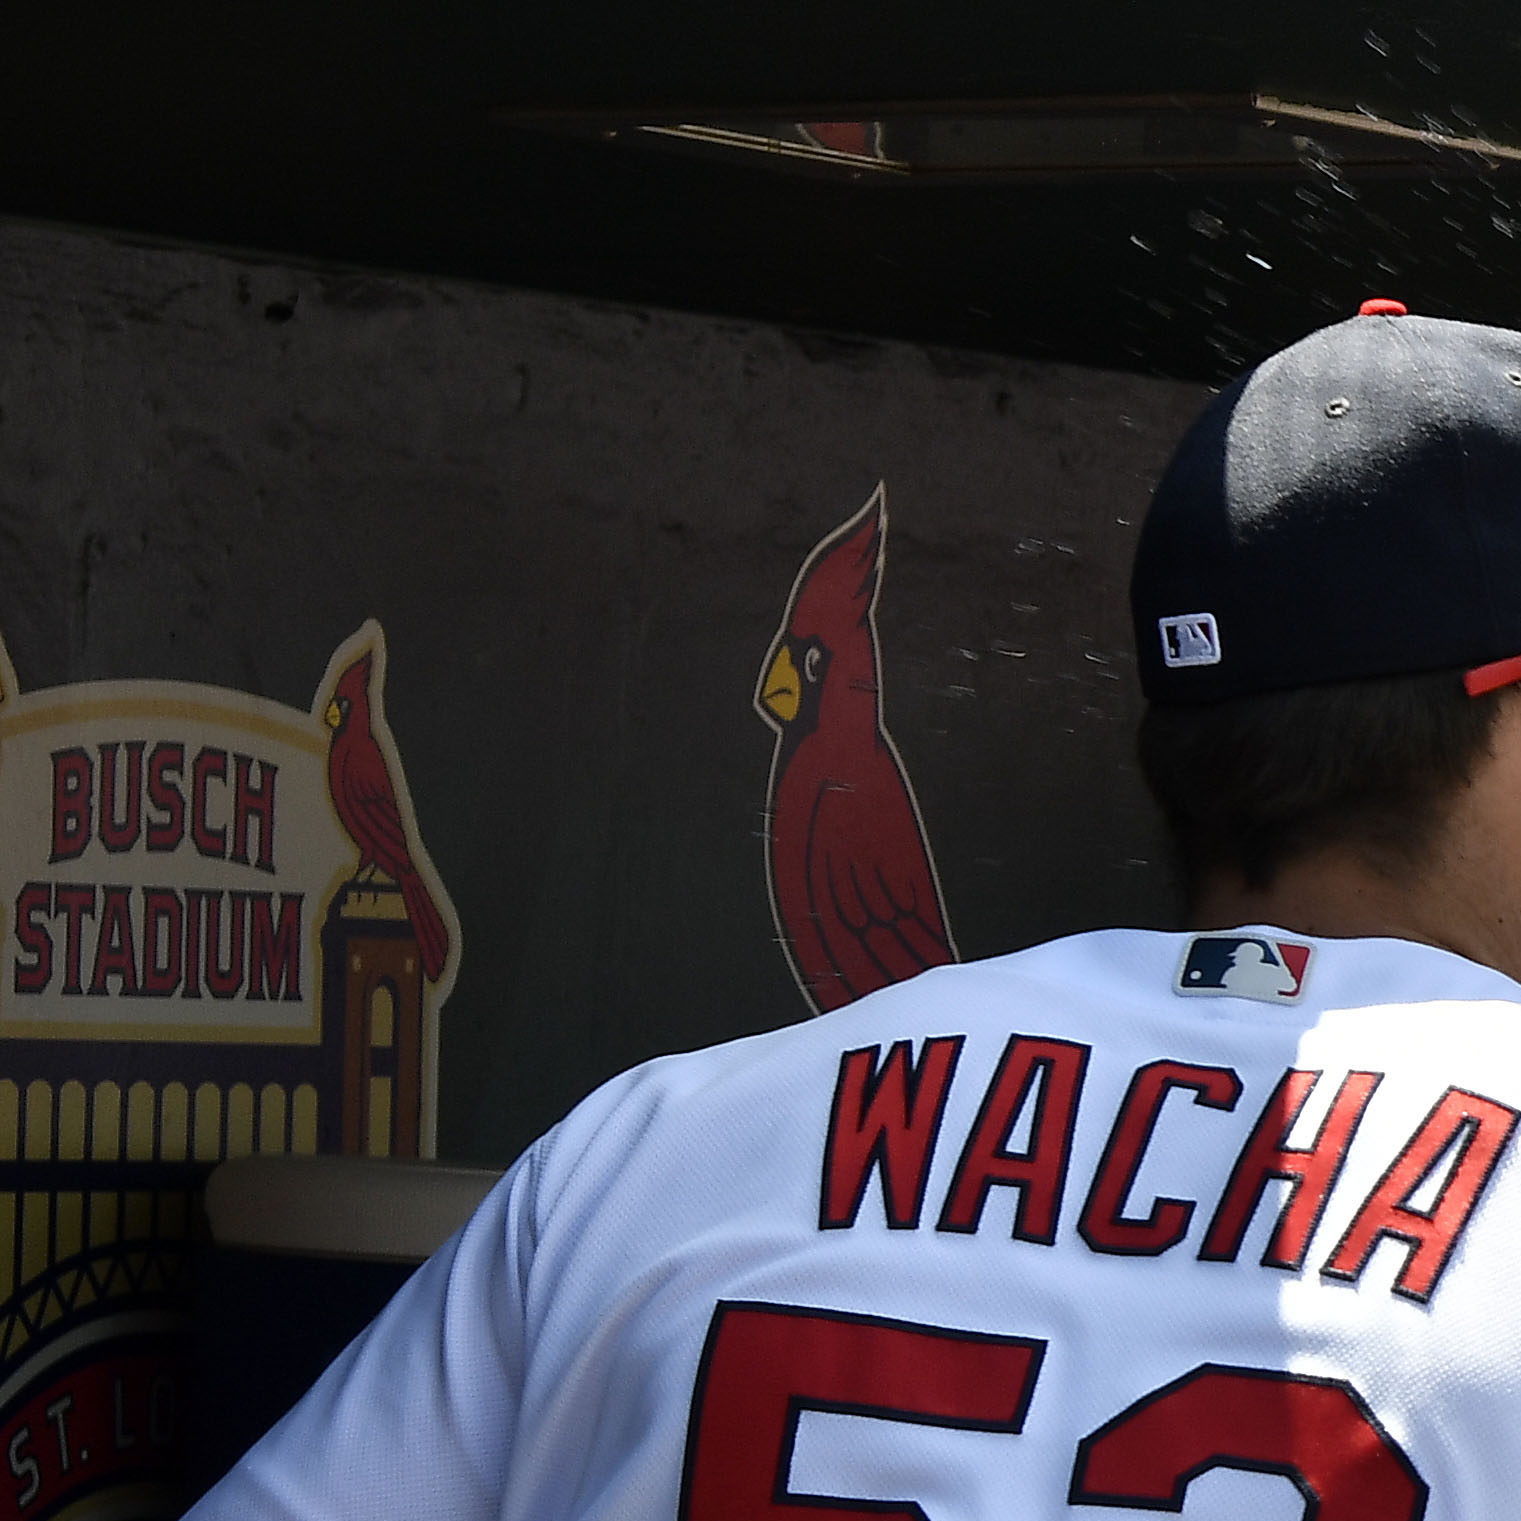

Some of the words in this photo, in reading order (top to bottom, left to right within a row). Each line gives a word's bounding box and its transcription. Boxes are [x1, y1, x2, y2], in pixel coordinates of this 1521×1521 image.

[48, 740, 280, 873] BUSCH
[14, 882, 305, 1002] STADIUM
[8, 1392, 89, 1511] ST.
